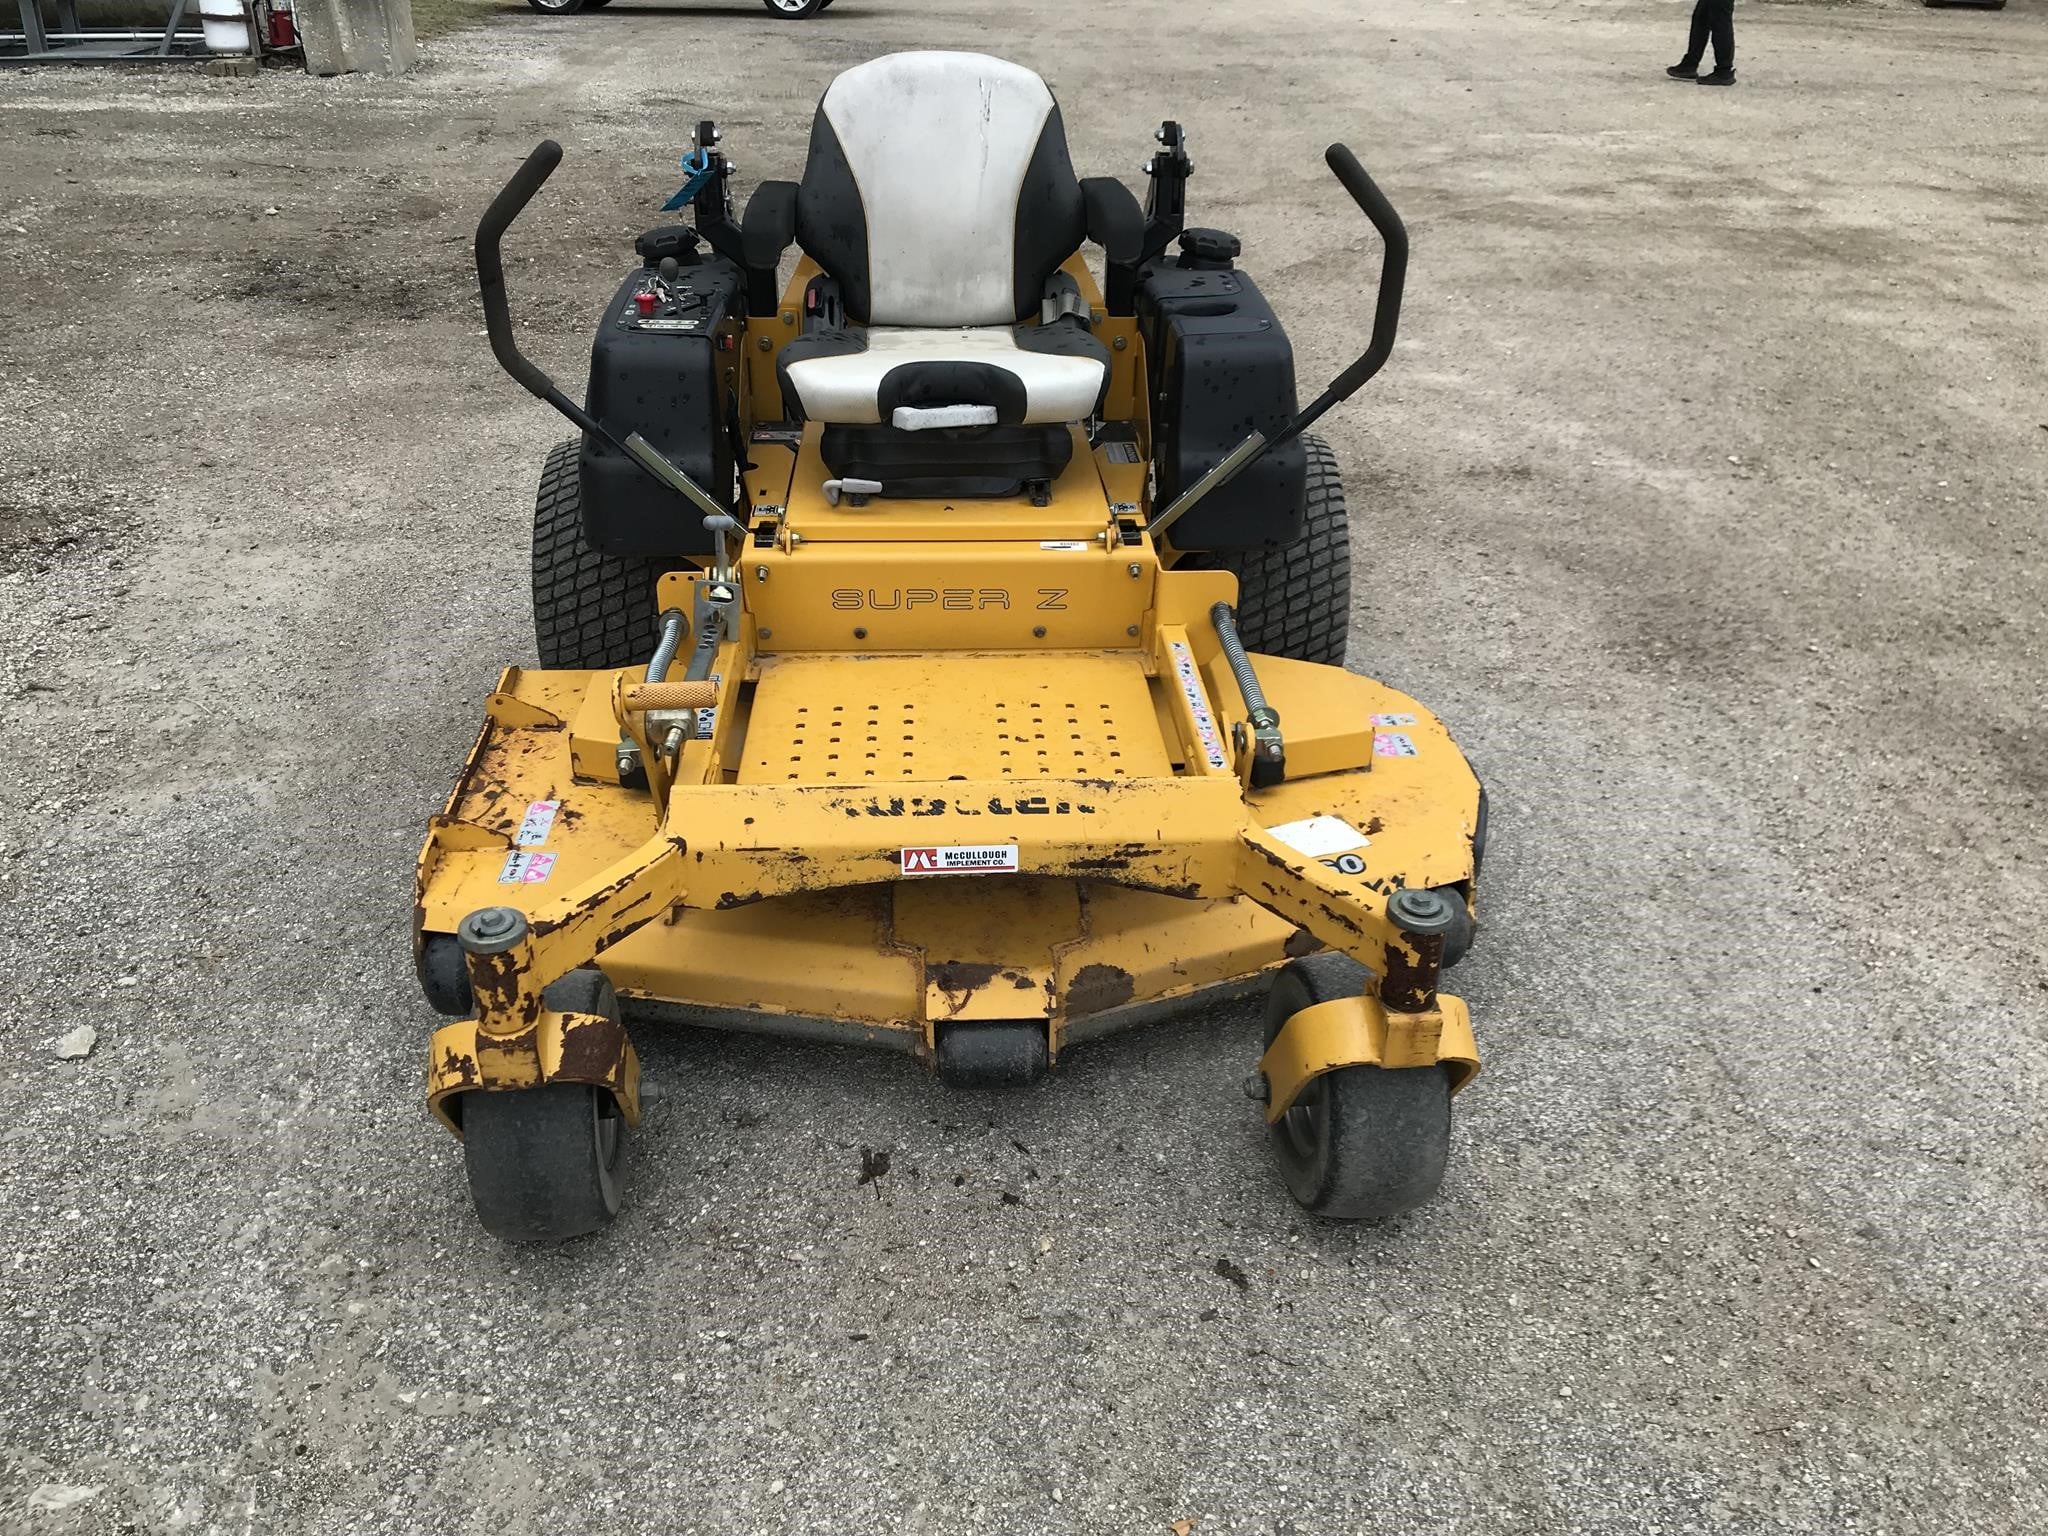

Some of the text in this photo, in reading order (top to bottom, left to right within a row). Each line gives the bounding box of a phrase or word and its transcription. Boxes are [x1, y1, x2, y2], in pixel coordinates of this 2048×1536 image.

[832, 588, 1068, 610] SUPER Z
[945, 850, 1007, 860] McCULLOUGH
